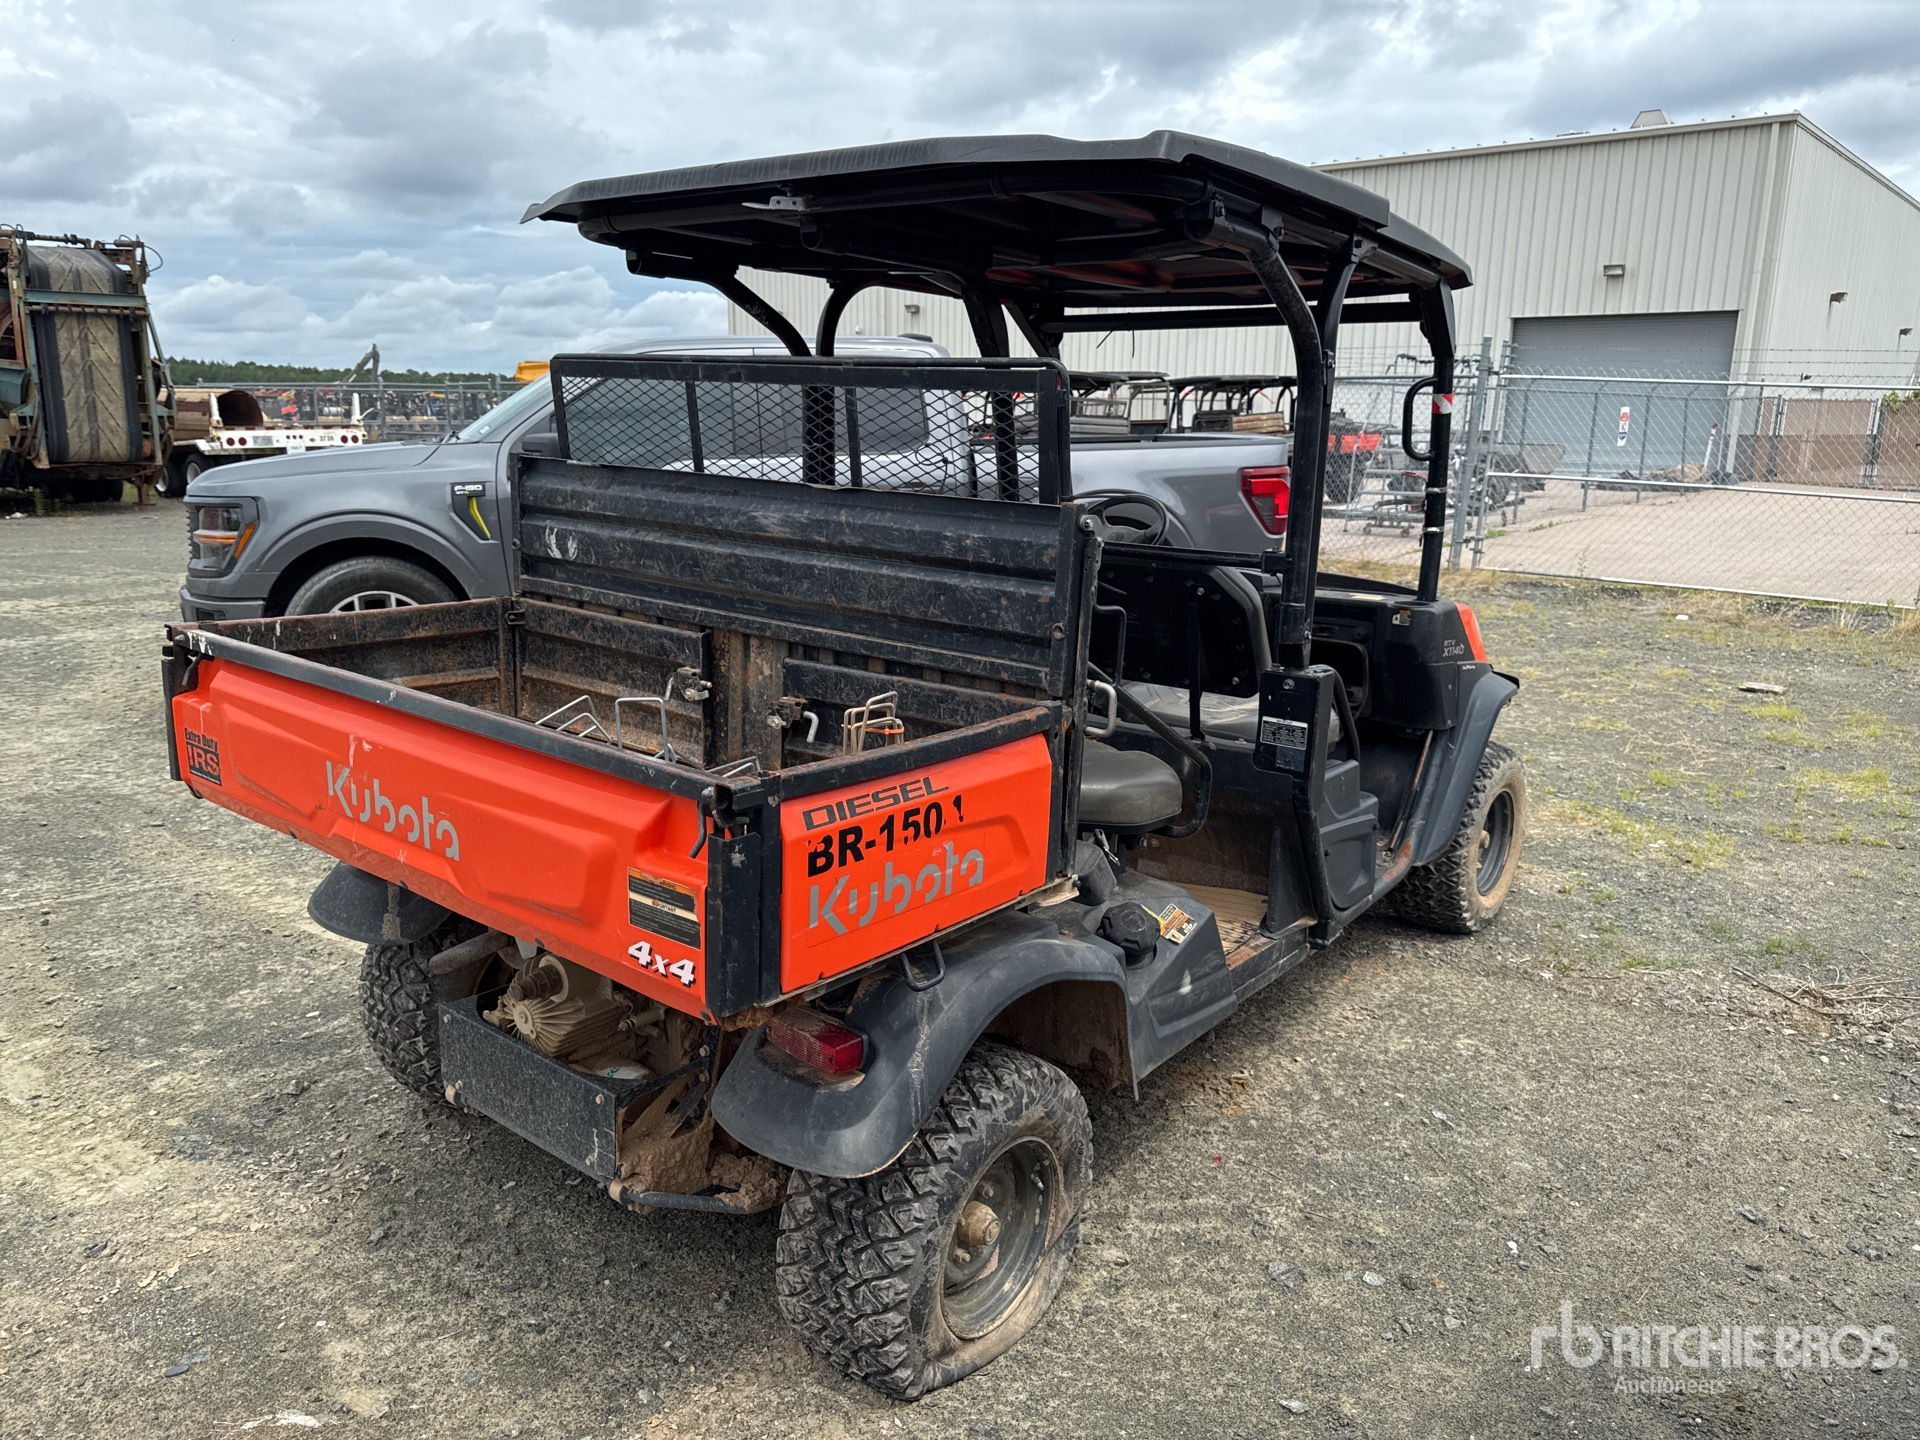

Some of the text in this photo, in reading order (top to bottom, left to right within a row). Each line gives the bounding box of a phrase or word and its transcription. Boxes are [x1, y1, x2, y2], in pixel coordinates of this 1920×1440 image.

[187, 744, 220, 776] IRS
[325, 760, 460, 862] Kubota
[802, 776, 949, 831] DIESEL
[808, 841, 984, 935] Kubota
[627, 940, 697, 988] 4x4
